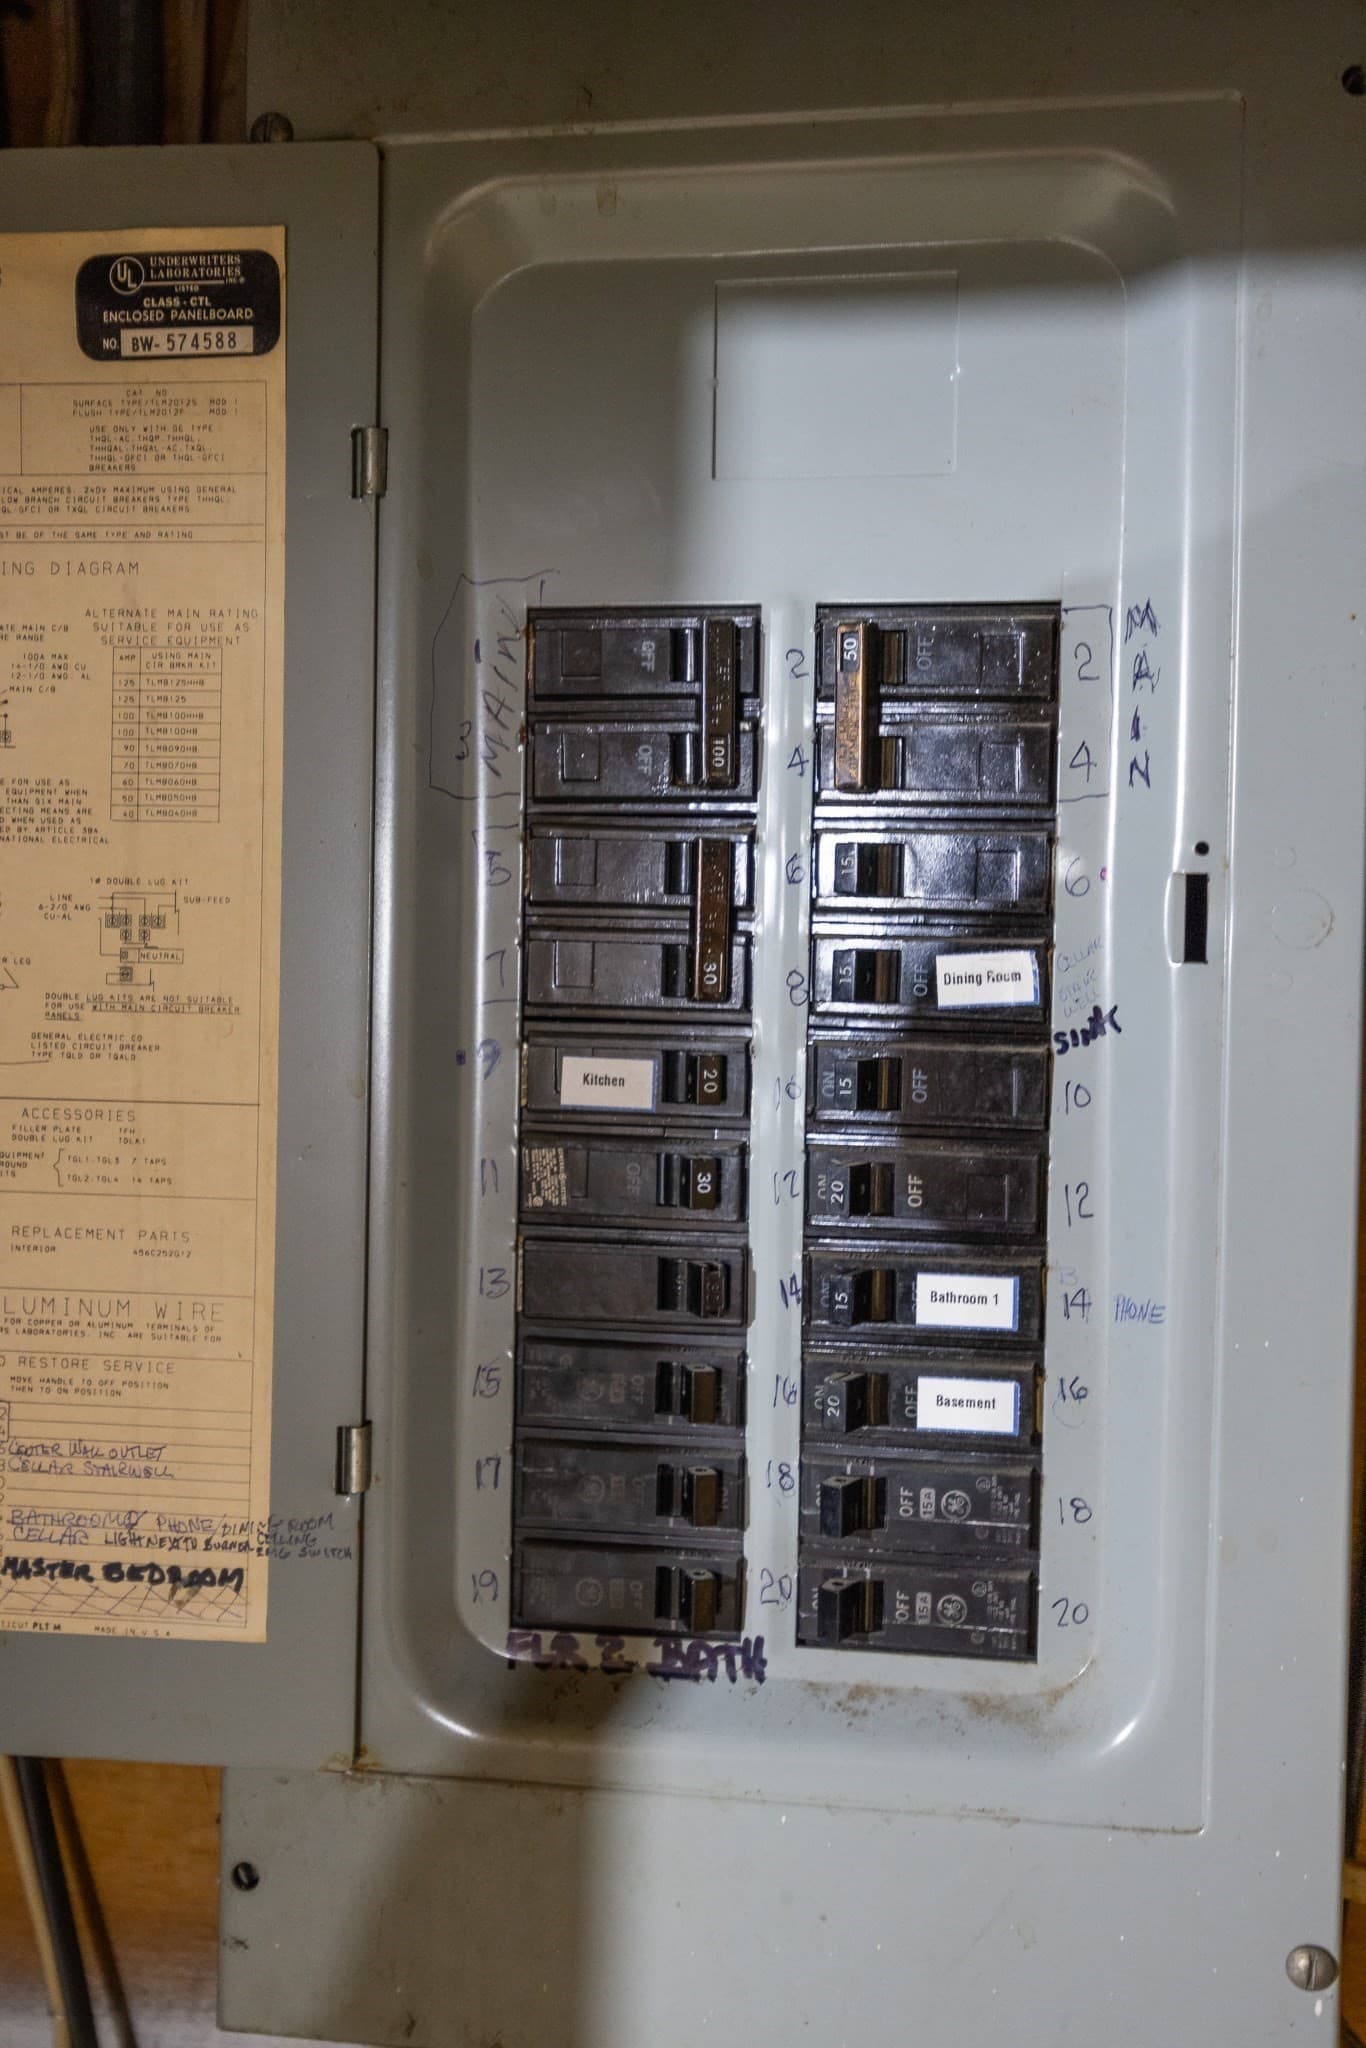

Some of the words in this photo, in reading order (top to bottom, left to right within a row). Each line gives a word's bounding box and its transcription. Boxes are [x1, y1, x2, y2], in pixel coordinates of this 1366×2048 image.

[150, 254, 241, 267] UNDERWRITERS
[150, 266, 242, 279] LABORATORIES
[174, 284, 200, 293] LISTED
[143, 297, 181, 308] CLASS
[190, 296, 212, 307] CTL
[103, 309, 164, 323] ENCLOSED
[170, 307, 254, 321] PANELBOARD
[50, 560, 140, 576] DIAGRAM
[85, 608, 157, 619] ALTERNATE
[167, 608, 200, 619] MAIN
[93, 621, 157, 632] SUITABLE
[167, 621, 192, 632] FOR
[200, 622, 224, 632] USE
[235, 622, 250, 632] AS
[100, 635, 157, 647] SERVICE
[167, 635, 241, 647] EQUIPMENT
[843, 637, 857, 661] 50
[916, 632, 935, 671] OFF
[785, 648, 809, 679] 2
[1074, 642, 1099, 681] 2
[454, 720, 472, 761] 3
[711, 739, 725, 768] 100
[787, 745, 810, 777] 4
[1069, 741, 1097, 782] 4
[486, 850, 512, 887] 5
[840, 855, 853, 876] 15
[1064, 856, 1091, 898] 6
[140, 951, 181, 962] NEUTRAL
[486, 949, 505, 988] 7
[703, 962, 718, 985] 30
[839, 965, 852, 985] 15
[913, 965, 928, 998] OFF
[943, 970, 983, 986] Dining
[786, 969, 809, 1006] 8
[31, 1032, 71, 1041] GENERAL
[78, 1032, 125, 1042] ELECTRIC
[1053, 1005, 1122, 1056] SINK
[31, 1041, 66, 1050] LISTED
[72, 1042, 112, 1051] CIRCUIT
[119, 1043, 160, 1052] BREAKER
[582, 1072, 625, 1088] Kitchen
[703, 1069, 719, 1094] 20
[838, 1076, 852, 1096] 15
[911, 1068, 928, 1103] OFF
[1065, 1080, 1092, 1115] 10
[21, 1107, 136, 1122] ACCESSORIES
[696, 1172, 712, 1195] 30
[774, 1169, 800, 1205] 12
[830, 1180, 844, 1205] 20
[907, 1173, 923, 1208] OFF
[1065, 1181, 1094, 1228] 12
[11, 1225, 125, 1240] REPLACEMENT
[138, 1229, 191, 1243] PARTS
[10, 1244, 57, 1254] INTERIOR
[478, 1266, 512, 1299] 13
[779, 1273, 801, 1309] 14
[835, 1291, 849, 1311] 15
[930, 1289, 991, 1306] Bathroom
[1063, 1286, 1092, 1324] 14
[1113, 1295, 1167, 1325] PHONE
[154, 1300, 225, 1322] WIRE
[27, 1318, 63, 1328] COPPER
[145, 1322, 199, 1333] TERMINALS
[17, 1355, 90, 1371] RESTORE
[103, 1358, 177, 1375] SERVICE
[10, 1375, 33, 1385] MOVE
[39, 1376, 74, 1386] HANDLE
[122, 1379, 169, 1390] POSITION
[10, 1385, 34, 1394] THEN
[74, 1387, 123, 1398] POSITION
[471, 1363, 501, 1398] 15
[772, 1373, 798, 1408] 16
[1058, 1375, 1089, 1404] 16
[826, 1394, 840, 1418] 20
[935, 1393, 996, 1410] Basement
[8, 1456, 73, 1475] CELLAR
[109, 1445, 167, 1461] OUTLET
[766, 1459, 795, 1492] 18
[899, 1486, 914, 1518] OFF
[922, 1490, 934, 1518] 15A
[1058, 1496, 1093, 1526] 18
[13, 1526, 89, 1546] CELLAR
[2, 1556, 95, 1583] MASTER
[103, 1561, 245, 1594] BEDROOM
[471, 1568, 499, 1603] 19
[760, 1567, 793, 1605] 20
[895, 1590, 910, 1623] OFF
[918, 1594, 930, 1622] 15A
[1052, 1598, 1089, 1628] 20
